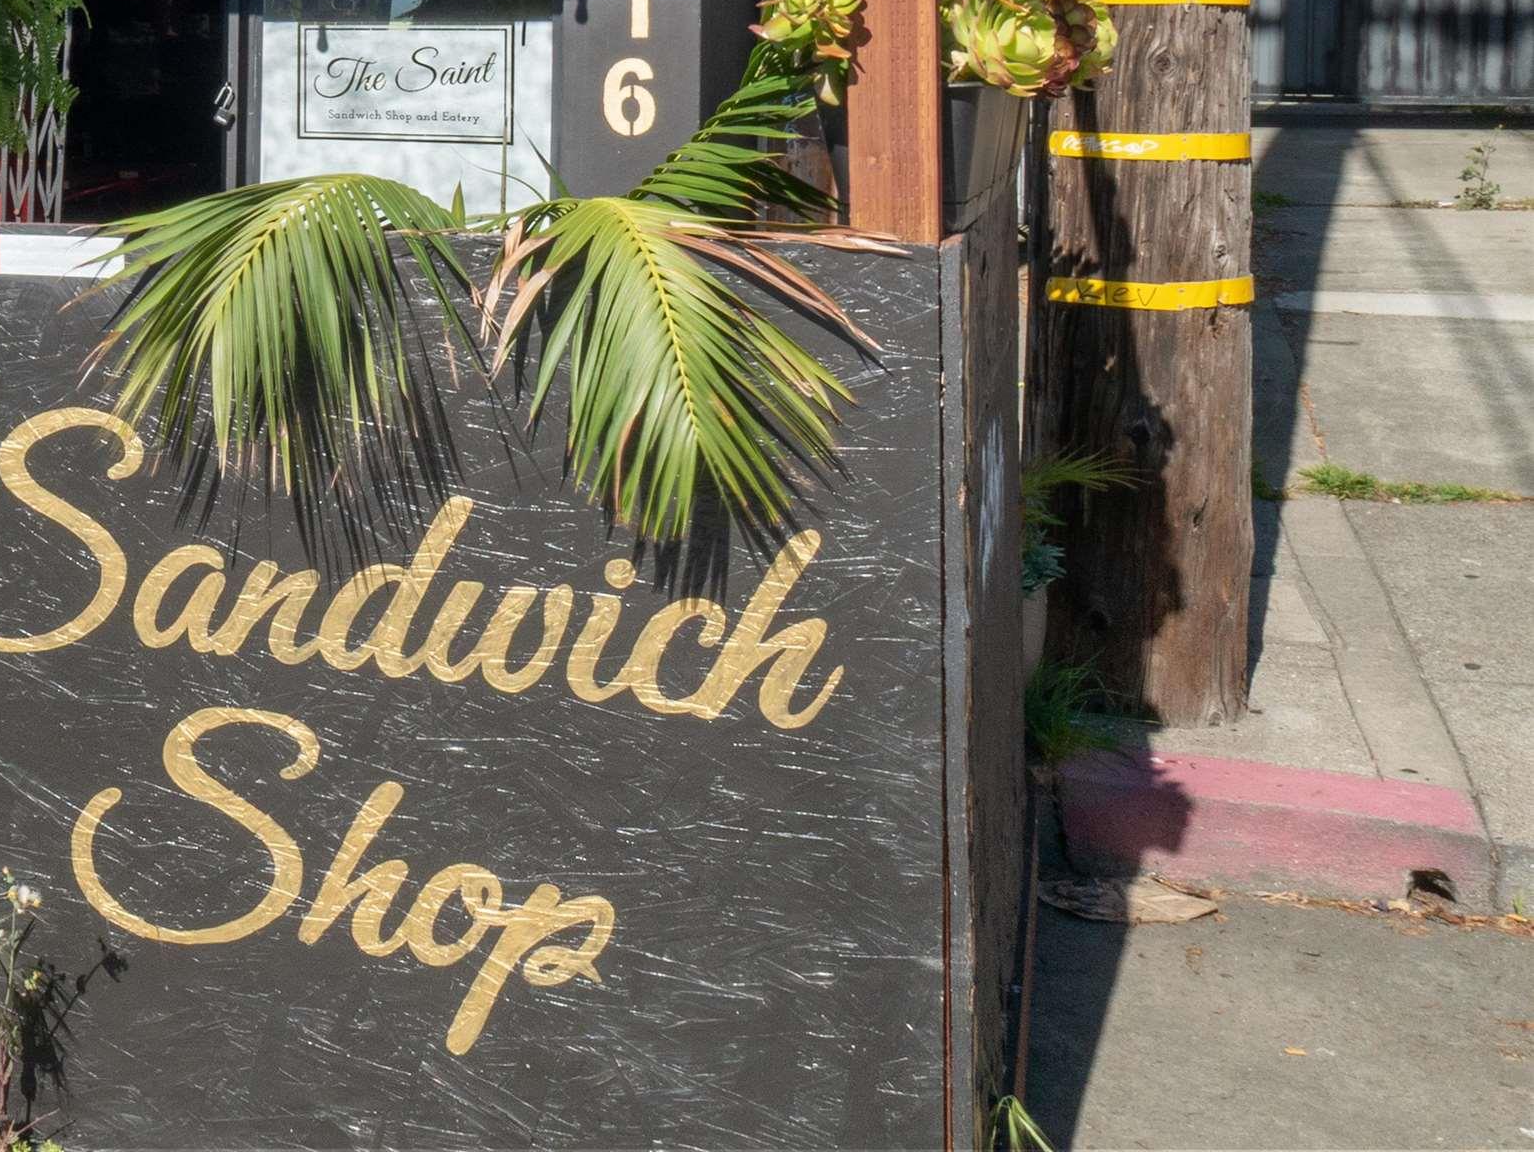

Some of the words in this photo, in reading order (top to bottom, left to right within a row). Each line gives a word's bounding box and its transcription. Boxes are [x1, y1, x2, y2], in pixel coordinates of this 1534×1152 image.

[314, 57, 386, 99] The
[395, 46, 497, 93] Saint
[328, 109, 382, 121] Sandwich
[385, 110, 412, 124] Shop
[416, 111, 438, 122] and
[442, 112, 480, 125] Eatery
[71, 706, 614, 1056] Shop
